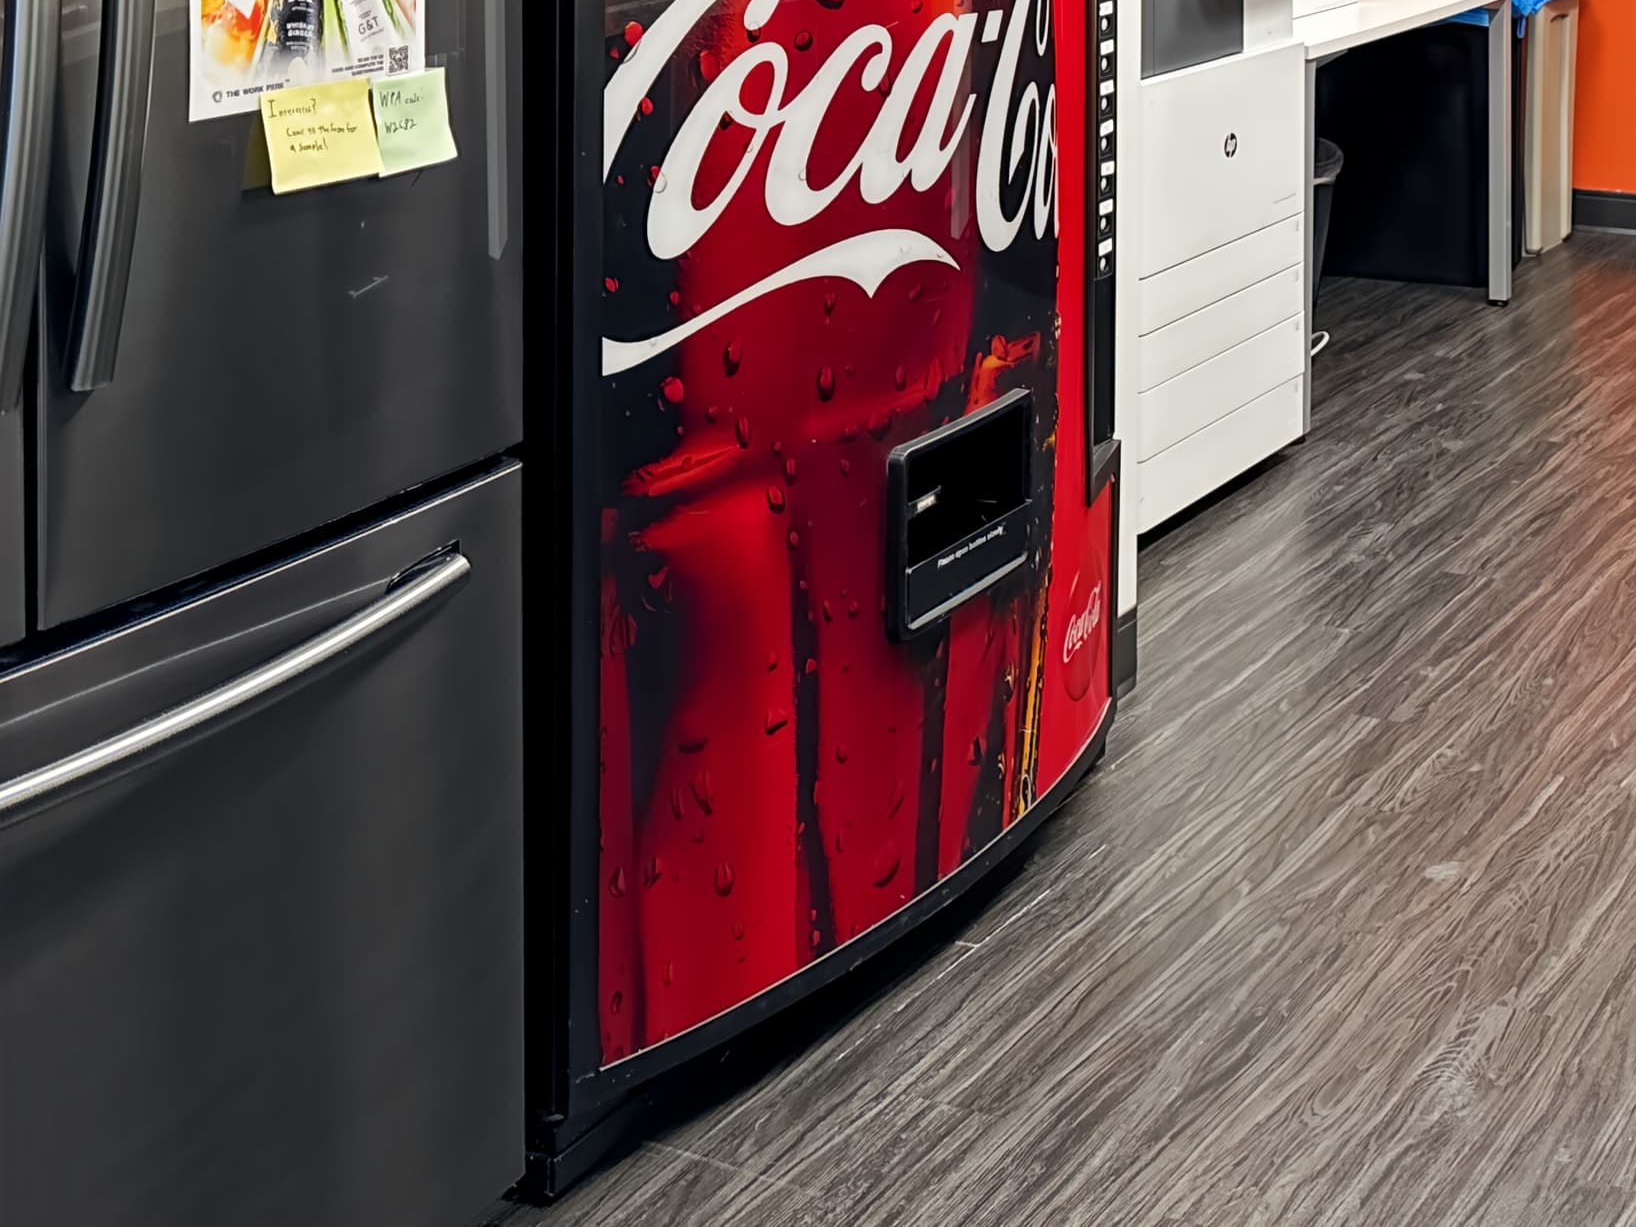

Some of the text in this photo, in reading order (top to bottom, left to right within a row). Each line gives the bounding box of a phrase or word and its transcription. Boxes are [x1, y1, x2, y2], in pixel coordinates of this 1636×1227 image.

[358, 16, 379, 35] G&T
[226, 90, 240, 99] THE
[243, 86, 263, 96] WORK
